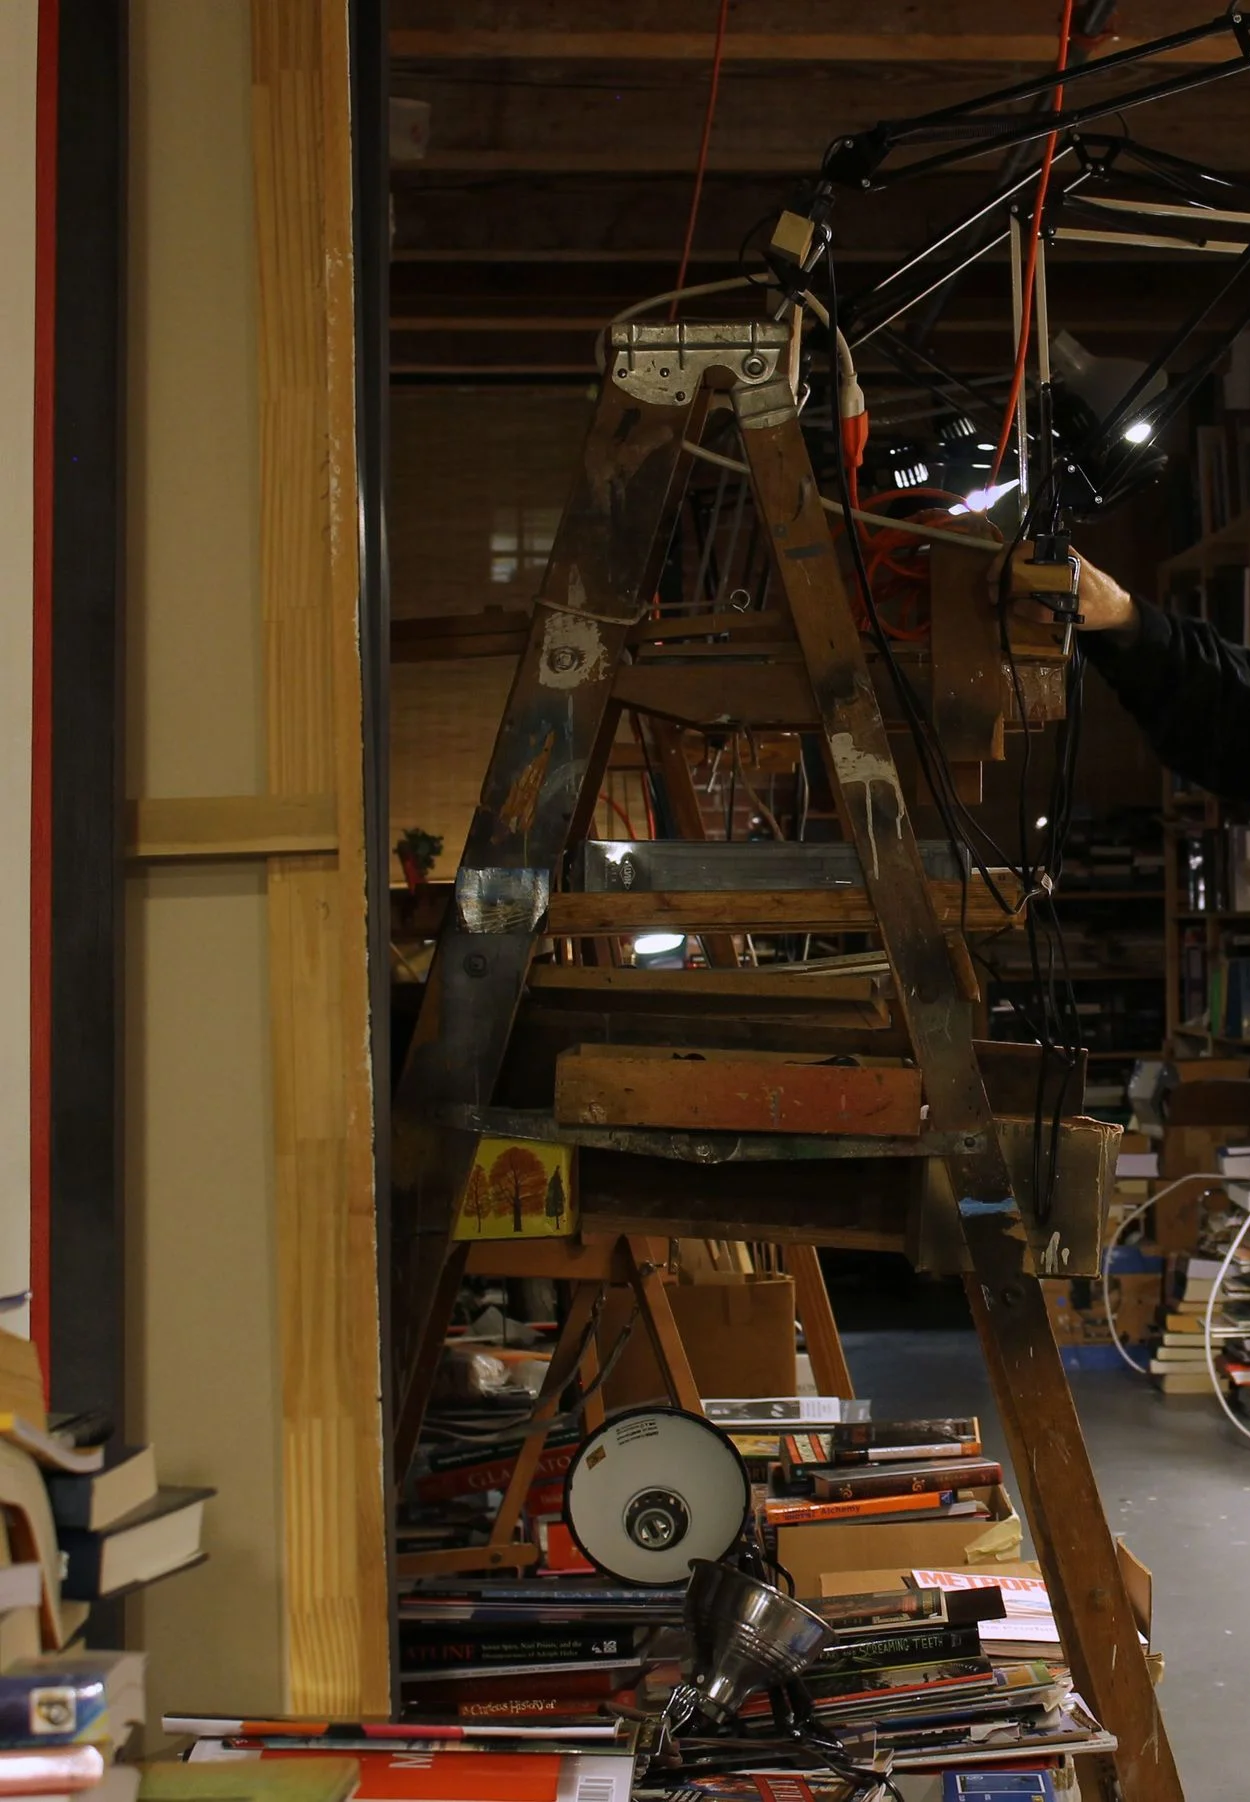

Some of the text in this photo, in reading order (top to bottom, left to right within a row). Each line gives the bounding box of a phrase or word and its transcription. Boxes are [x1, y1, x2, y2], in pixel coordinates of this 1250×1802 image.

[468, 1455, 571, 1489] GLAATO
[820, 1504, 861, 1516] Alchemy
[859, 1638, 910, 1657] SCREAMING
[913, 1635, 944, 1650] TEETH
